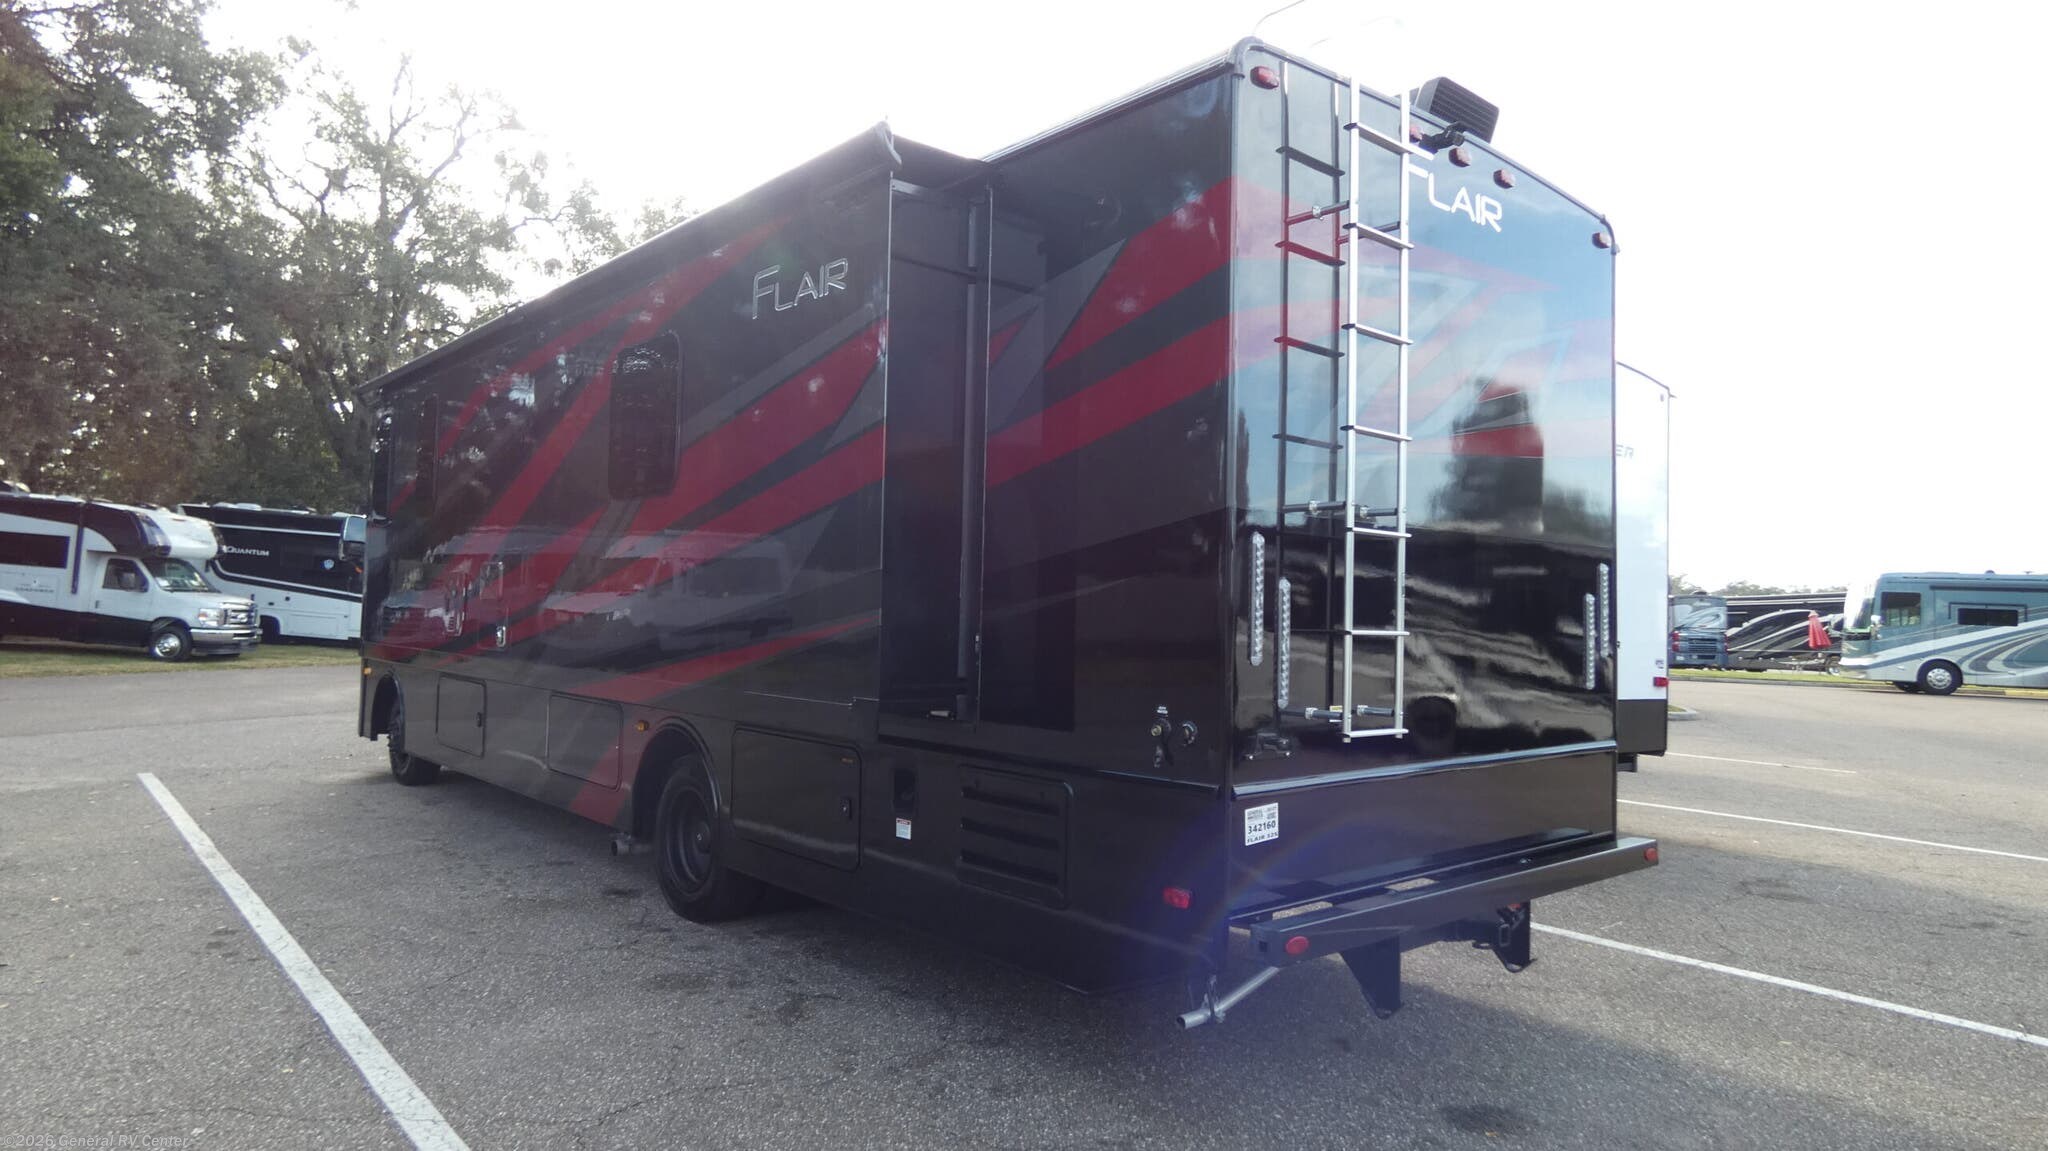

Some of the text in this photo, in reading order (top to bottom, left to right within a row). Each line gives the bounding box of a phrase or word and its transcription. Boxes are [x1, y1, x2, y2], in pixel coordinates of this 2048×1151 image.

[752, 258, 848, 319] FLAIR
[226, 545, 270, 556] QUANTUM
[1248, 820, 1276, 834] 342160
